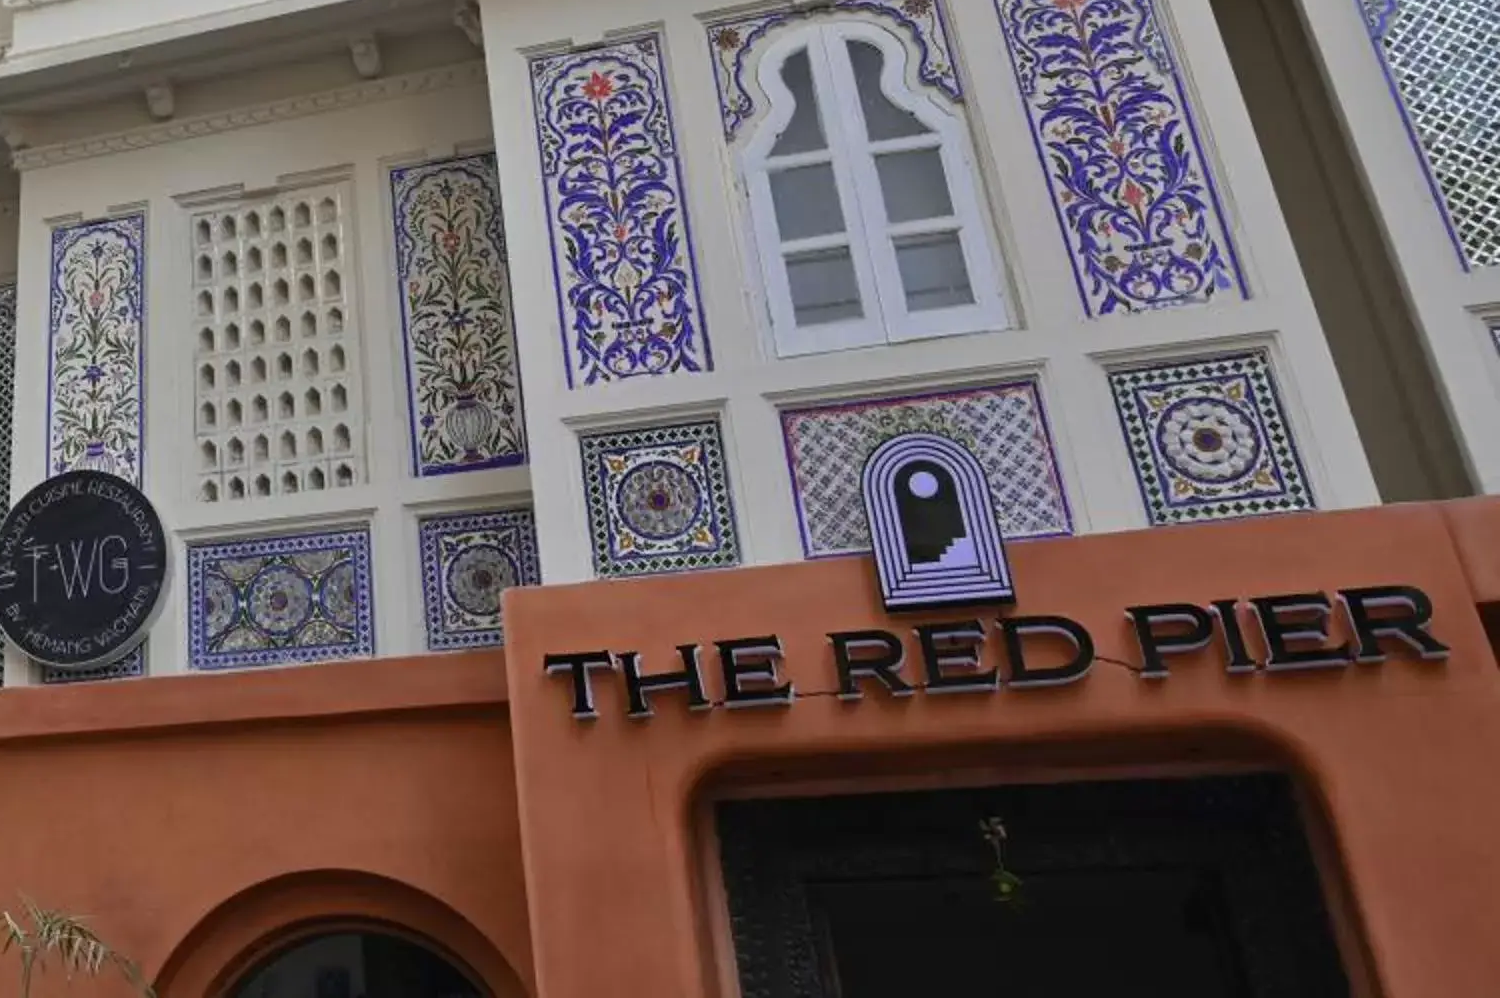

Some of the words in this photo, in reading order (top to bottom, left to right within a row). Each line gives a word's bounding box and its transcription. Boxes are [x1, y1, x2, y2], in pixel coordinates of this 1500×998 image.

[22, 534, 129, 604] TWG
[543, 634, 796, 720] THE
[827, 615, 1095, 701] RED
[1123, 585, 1450, 679] PIER
